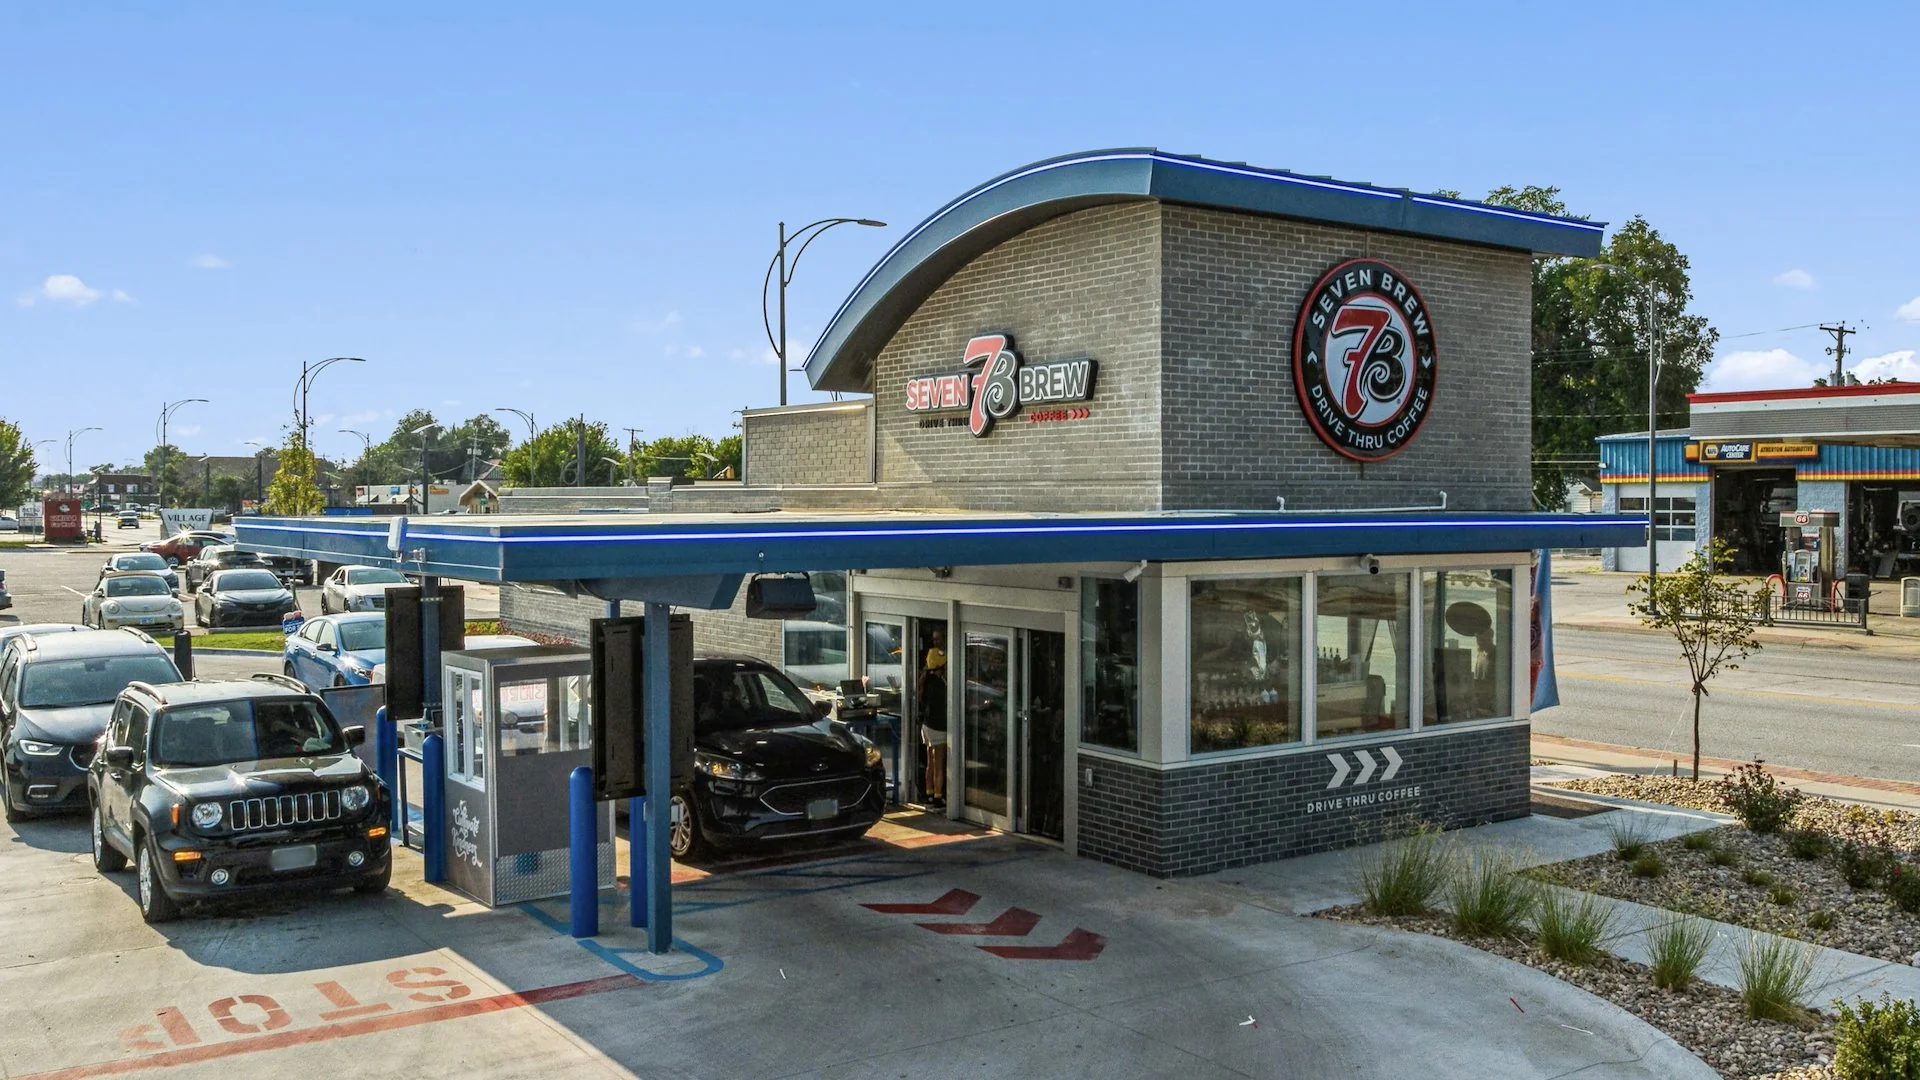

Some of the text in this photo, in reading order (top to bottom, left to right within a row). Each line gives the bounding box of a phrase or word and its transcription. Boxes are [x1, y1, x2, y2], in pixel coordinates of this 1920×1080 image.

[1312, 269, 1429, 335] SEVEN BREW
[905, 360, 1090, 410] SEVEN BREW
[919, 418, 969, 429] DRIVE THRU
[1028, 410, 1068, 423] COFFEE
[1312, 385, 1428, 449] DRIVE THRU COFFEE
[1306, 786, 1421, 814] DRIVE THRU COFFEE
